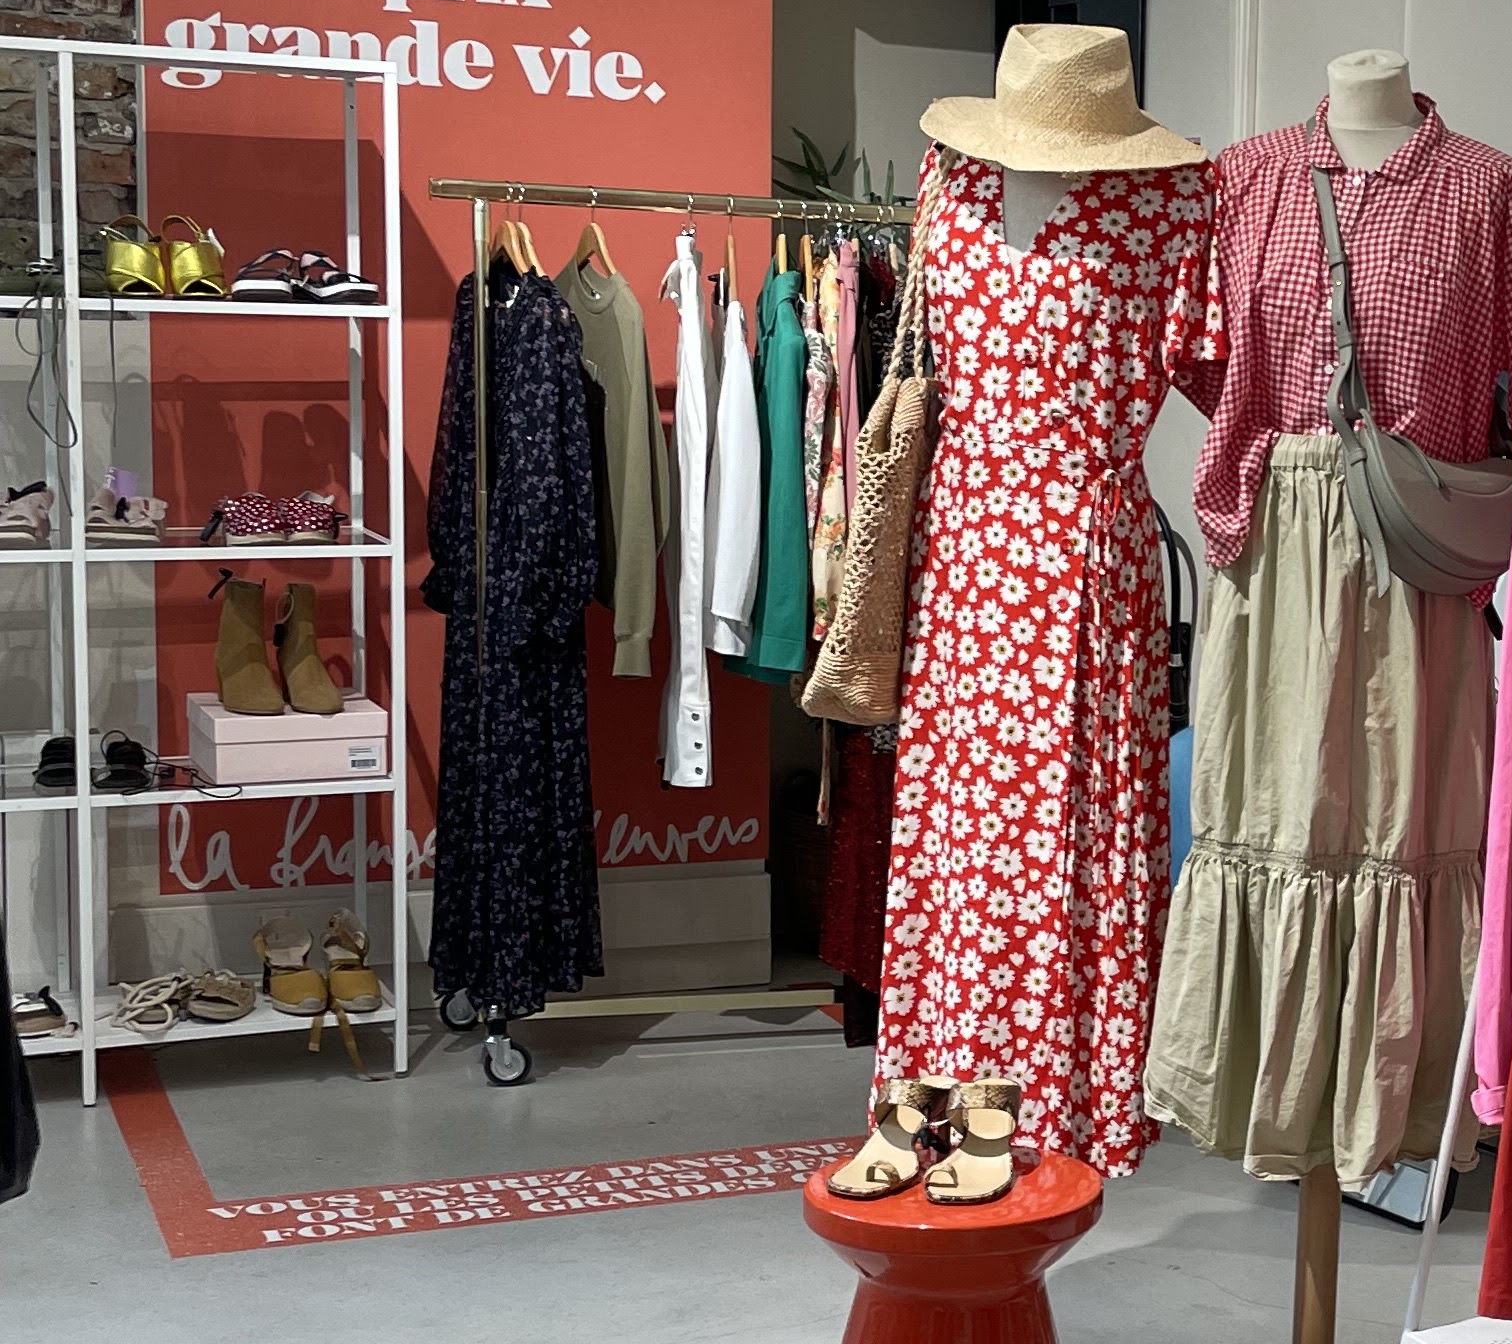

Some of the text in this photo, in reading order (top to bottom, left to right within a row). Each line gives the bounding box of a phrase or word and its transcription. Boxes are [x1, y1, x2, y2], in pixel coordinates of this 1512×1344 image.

[161, 12, 667, 104] grande vie.
[168, 804, 250, 890] la
[207, 1142, 854, 1218] VOUS ENTREZ DANS UNE
[261, 1215, 414, 1243] FONT
[433, 1206, 510, 1224] DE
[528, 1176, 777, 1212] GRANDES
[297, 1205, 374, 1223] OU
[396, 1193, 500, 1214] LES
[517, 1170, 707, 1201] PETITS
